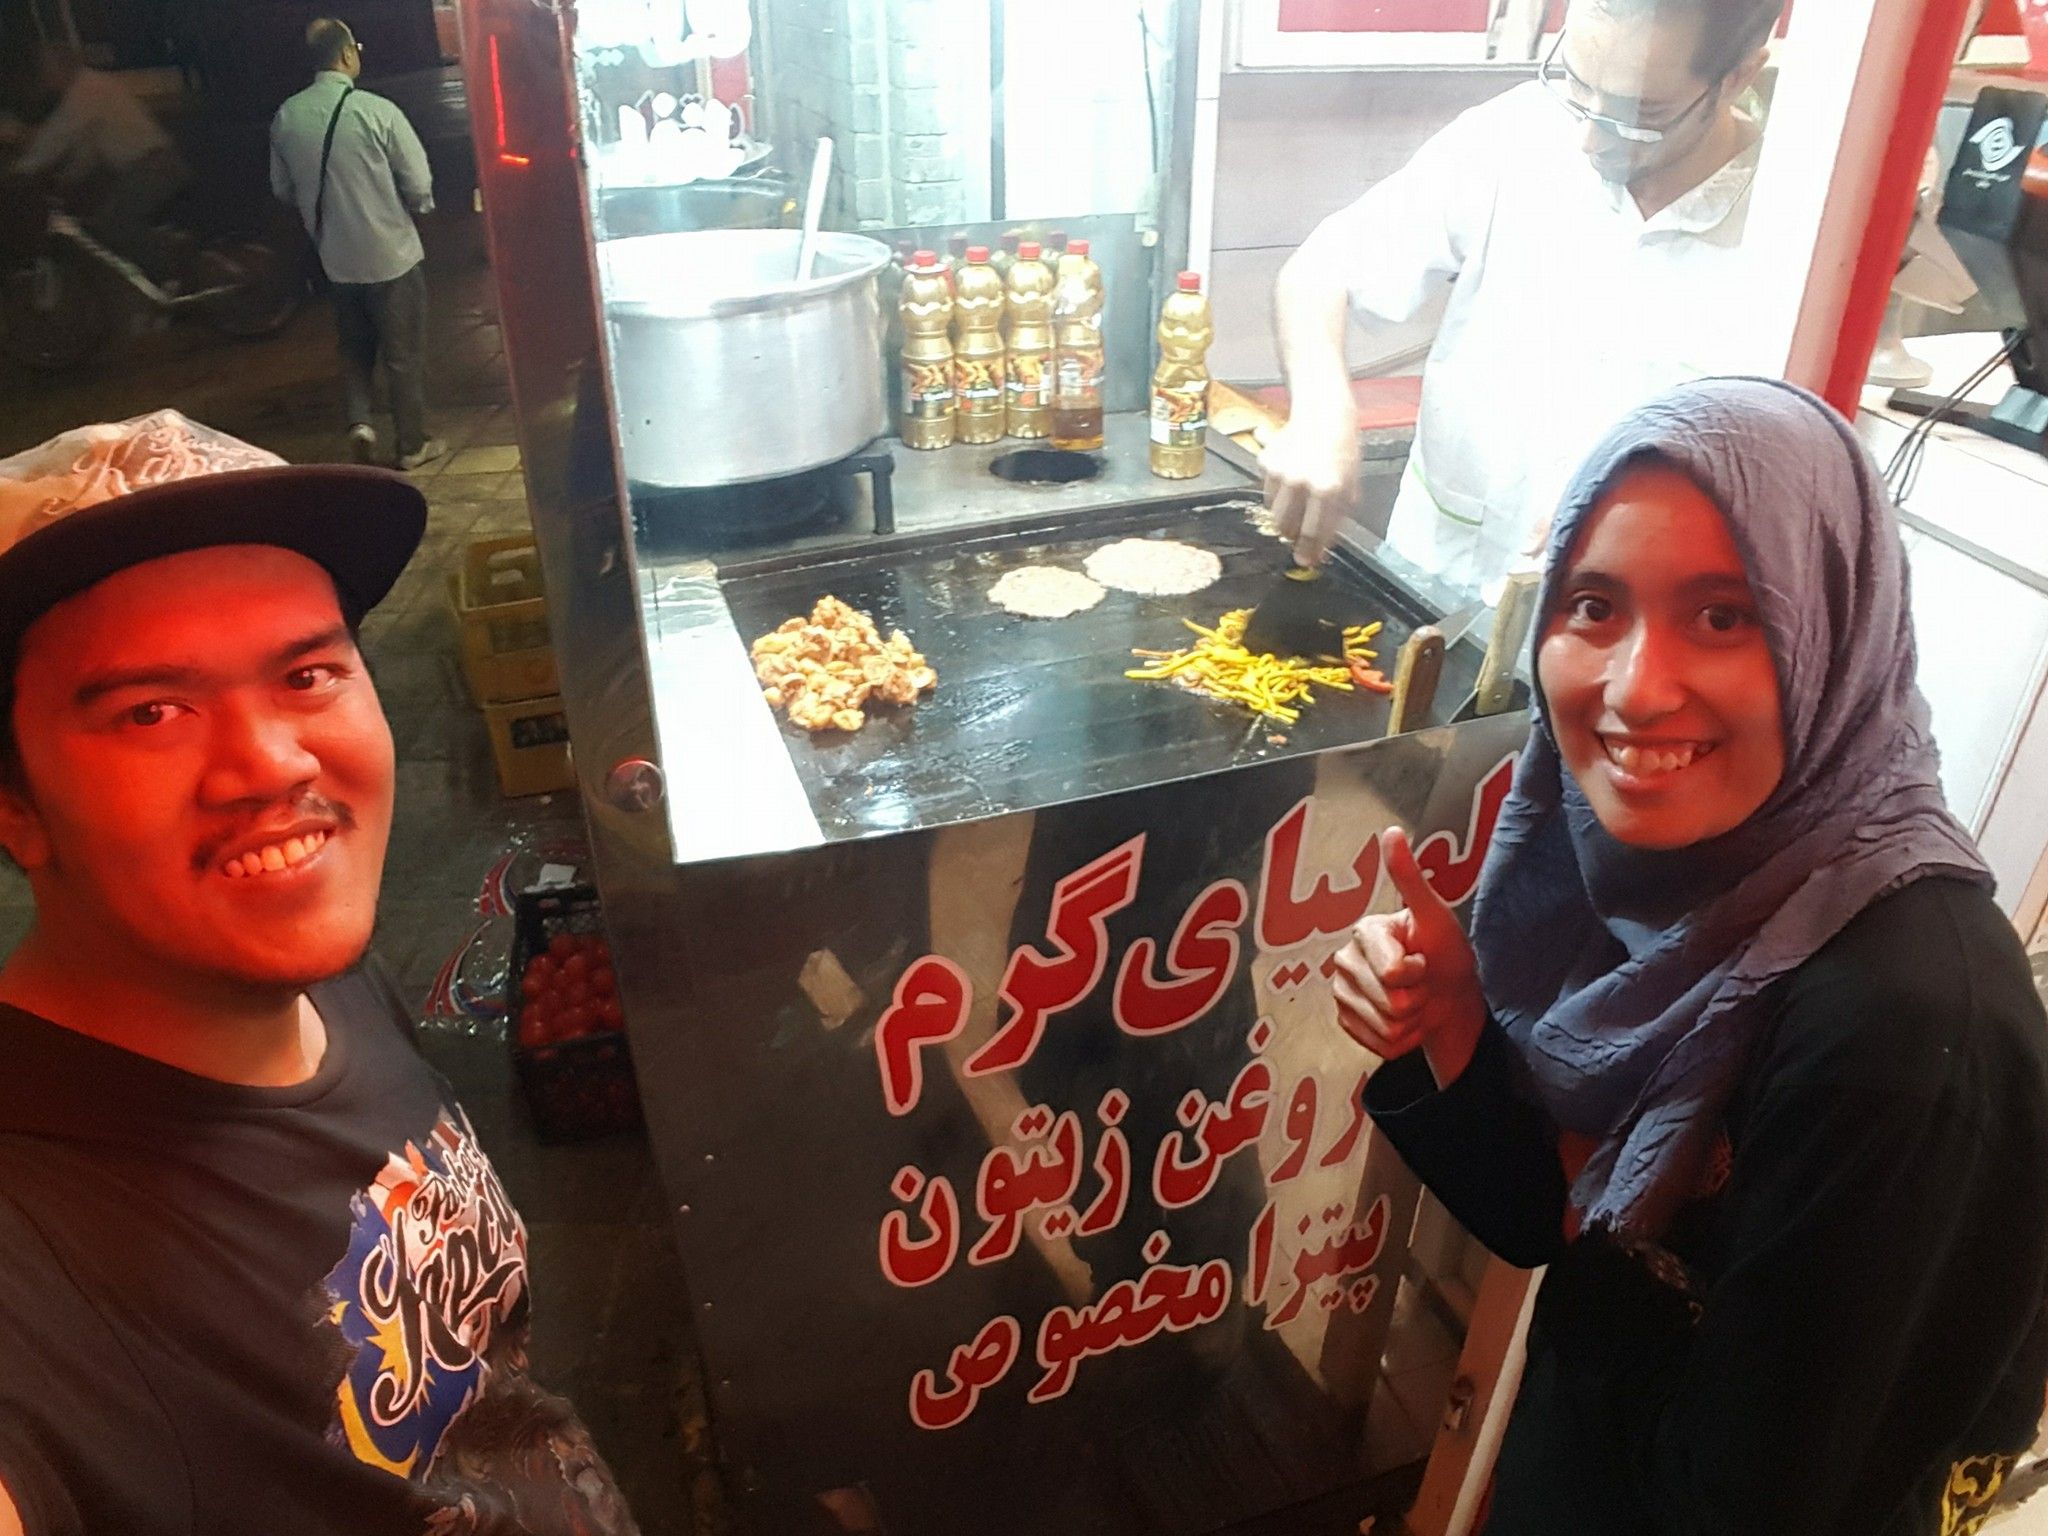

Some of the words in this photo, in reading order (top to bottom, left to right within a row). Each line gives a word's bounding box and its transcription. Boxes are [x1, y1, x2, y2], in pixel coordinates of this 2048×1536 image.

[875, 832, 1147, 1117] گرم
[879, 1088, 1131, 1288] زیتون
[1153, 1016, 1373, 1209] روغن
[909, 1230, 1232, 1430] مخصوص
[1248, 1193, 1391, 1331] پیتزا
